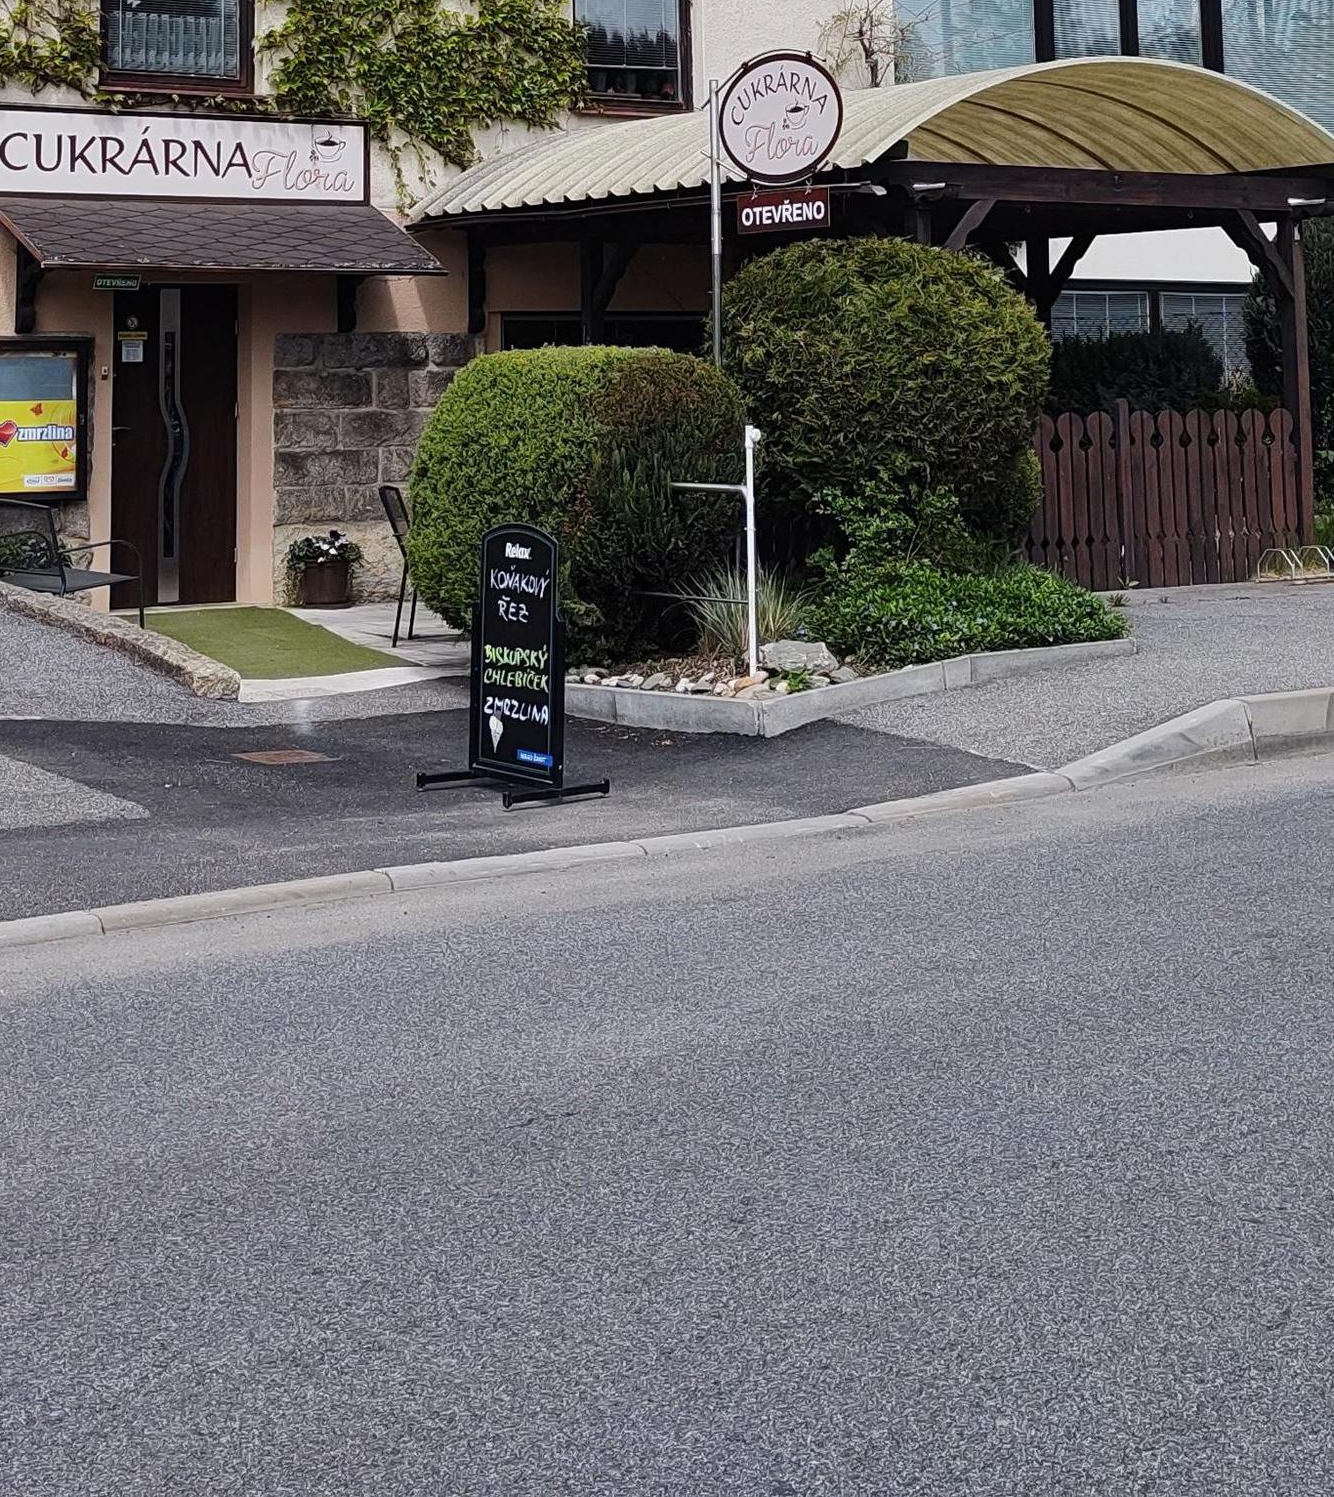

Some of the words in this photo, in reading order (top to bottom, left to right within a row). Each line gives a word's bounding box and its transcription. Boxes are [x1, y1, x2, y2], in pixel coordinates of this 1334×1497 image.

[731, 65, 829, 126] CUKRÁRNA
[745, 121, 819, 164] Flora
[251, 149, 356, 193] Flora
[741, 199, 826, 227] OTEVŘENO
[17, 425, 73, 441] zmrzlina
[490, 565, 550, 600] KOŇAKOVÝ
[497, 595, 529, 623] ŘEZ
[484, 644, 548, 669] BISKUPSKÝ
[483, 668, 549, 694] CHLEBÍČEK
[483, 696, 549, 725] ZMRZLINA
